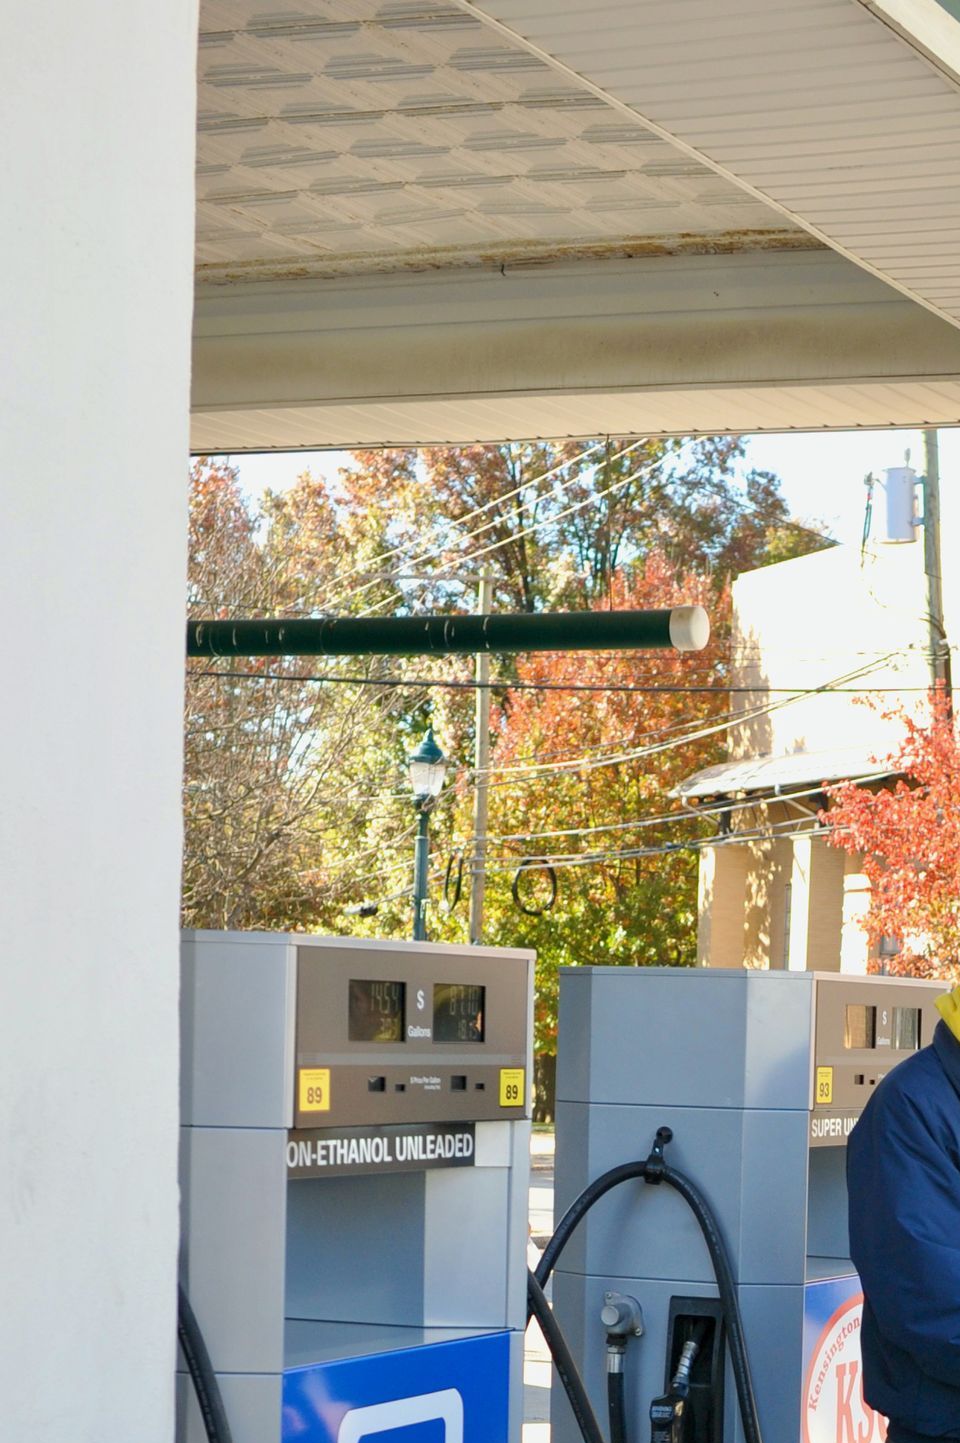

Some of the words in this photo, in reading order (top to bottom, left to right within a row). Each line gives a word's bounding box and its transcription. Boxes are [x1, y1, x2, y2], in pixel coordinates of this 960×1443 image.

[408, 1025, 431, 1037] Gallons
[306, 1087, 322, 1104] 89
[506, 1084, 518, 1100] 89
[819, 1082, 830, 1097] 93
[811, 1117, 842, 1137] SUPER
[287, 1136, 392, 1168] ON-ETHANOL
[395, 1133, 473, 1161] UNLEADED
[808, 1315, 861, 1412] Kensington
